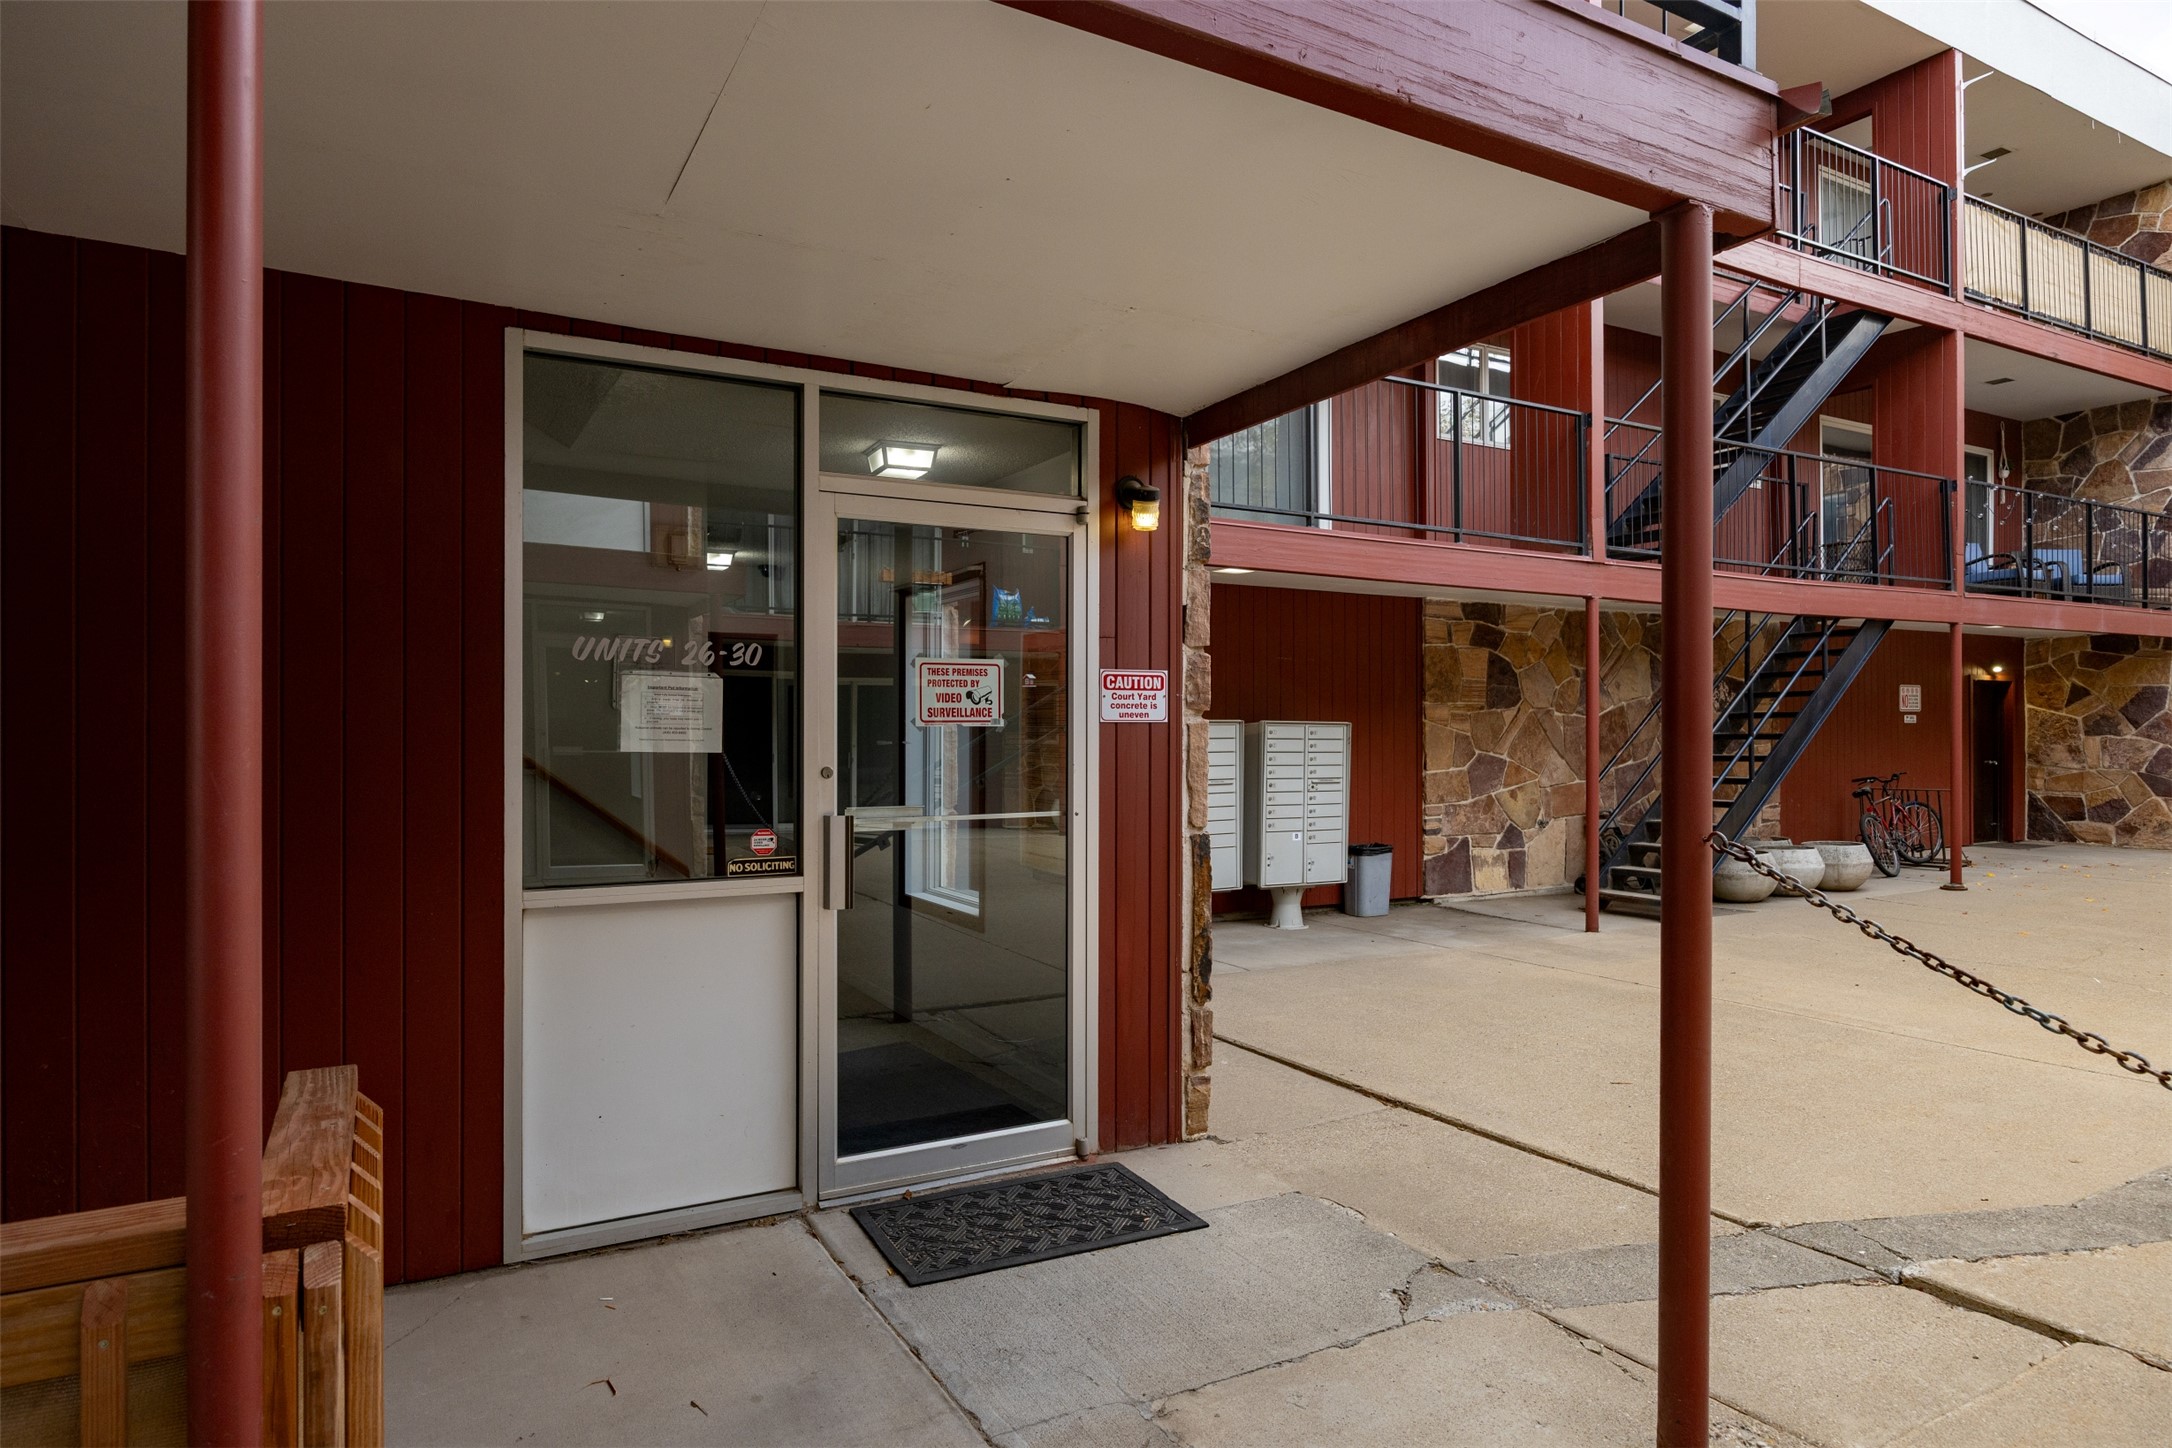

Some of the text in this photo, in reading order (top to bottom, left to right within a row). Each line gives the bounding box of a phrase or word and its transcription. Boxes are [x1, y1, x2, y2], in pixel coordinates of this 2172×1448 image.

[572, 636, 762, 666] UNITS 26-30
[927, 668, 988, 677] THESE PREMISES
[927, 679, 980, 688] PROTECTED BY
[1106, 675, 1162, 690] CAUTION
[935, 692, 962, 703] VIDEO
[1111, 692, 1157, 700] Court Yard
[1110, 701, 1158, 709] concrete is
[927, 707, 993, 718] SURVEILLANCE
[729, 860, 795, 873] NO SOLICITING
